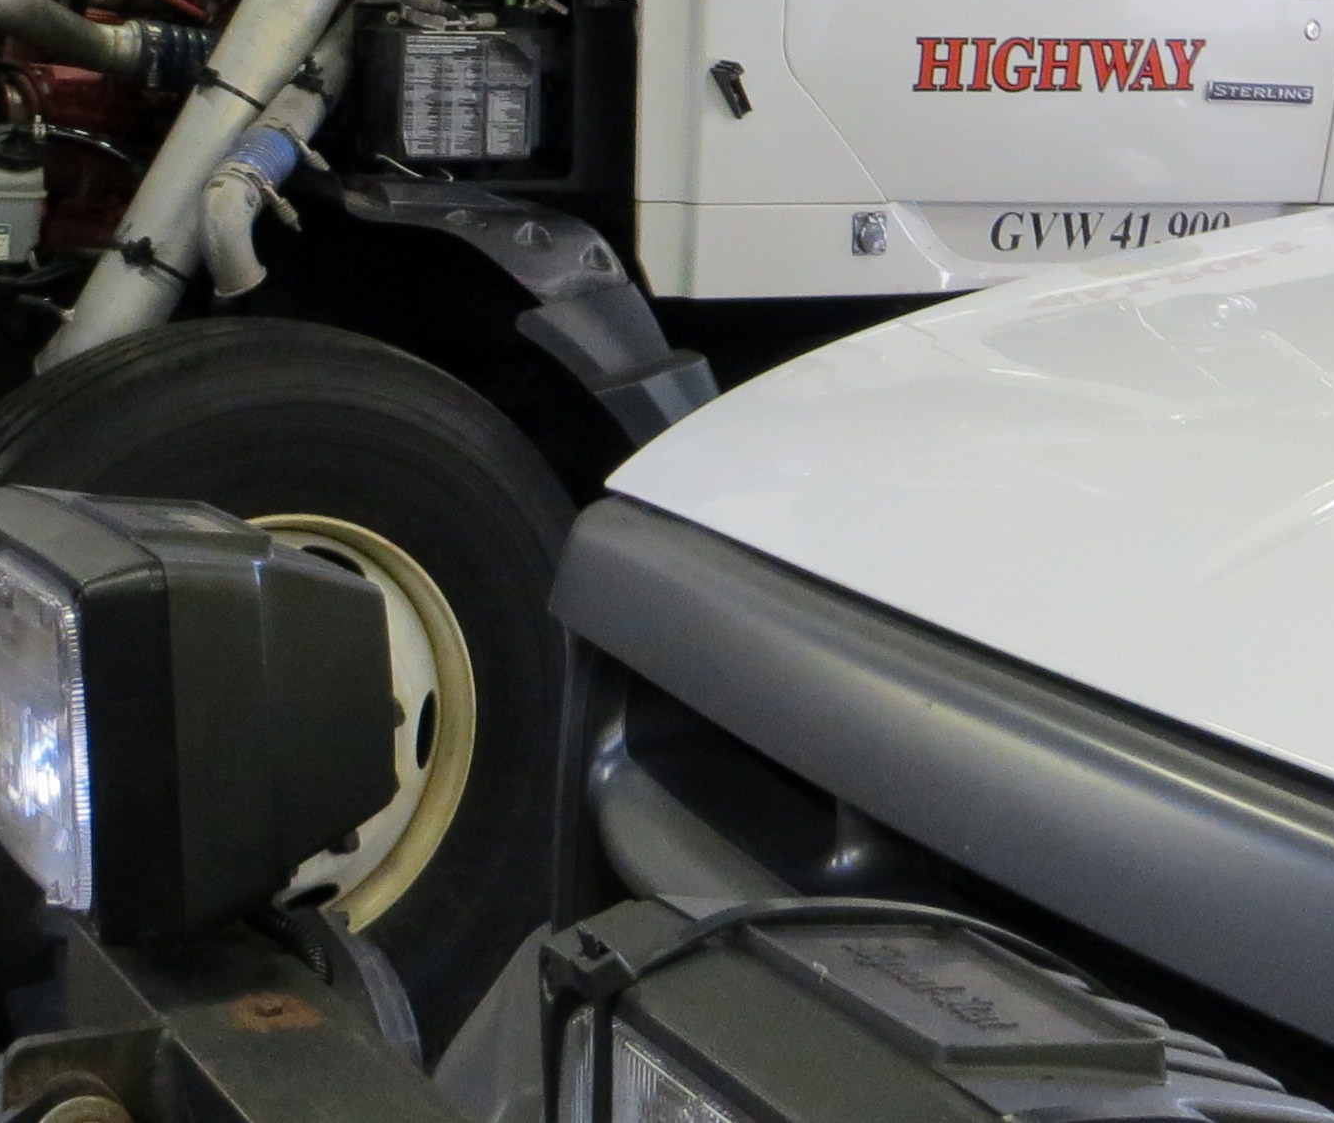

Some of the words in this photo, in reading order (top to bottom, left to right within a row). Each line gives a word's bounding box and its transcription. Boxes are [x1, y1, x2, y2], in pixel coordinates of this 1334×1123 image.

[913, 37, 1206, 93] HIGHWAY
[1212, 82, 1312, 101] STERLING
[990, 211, 1105, 251] GVW
